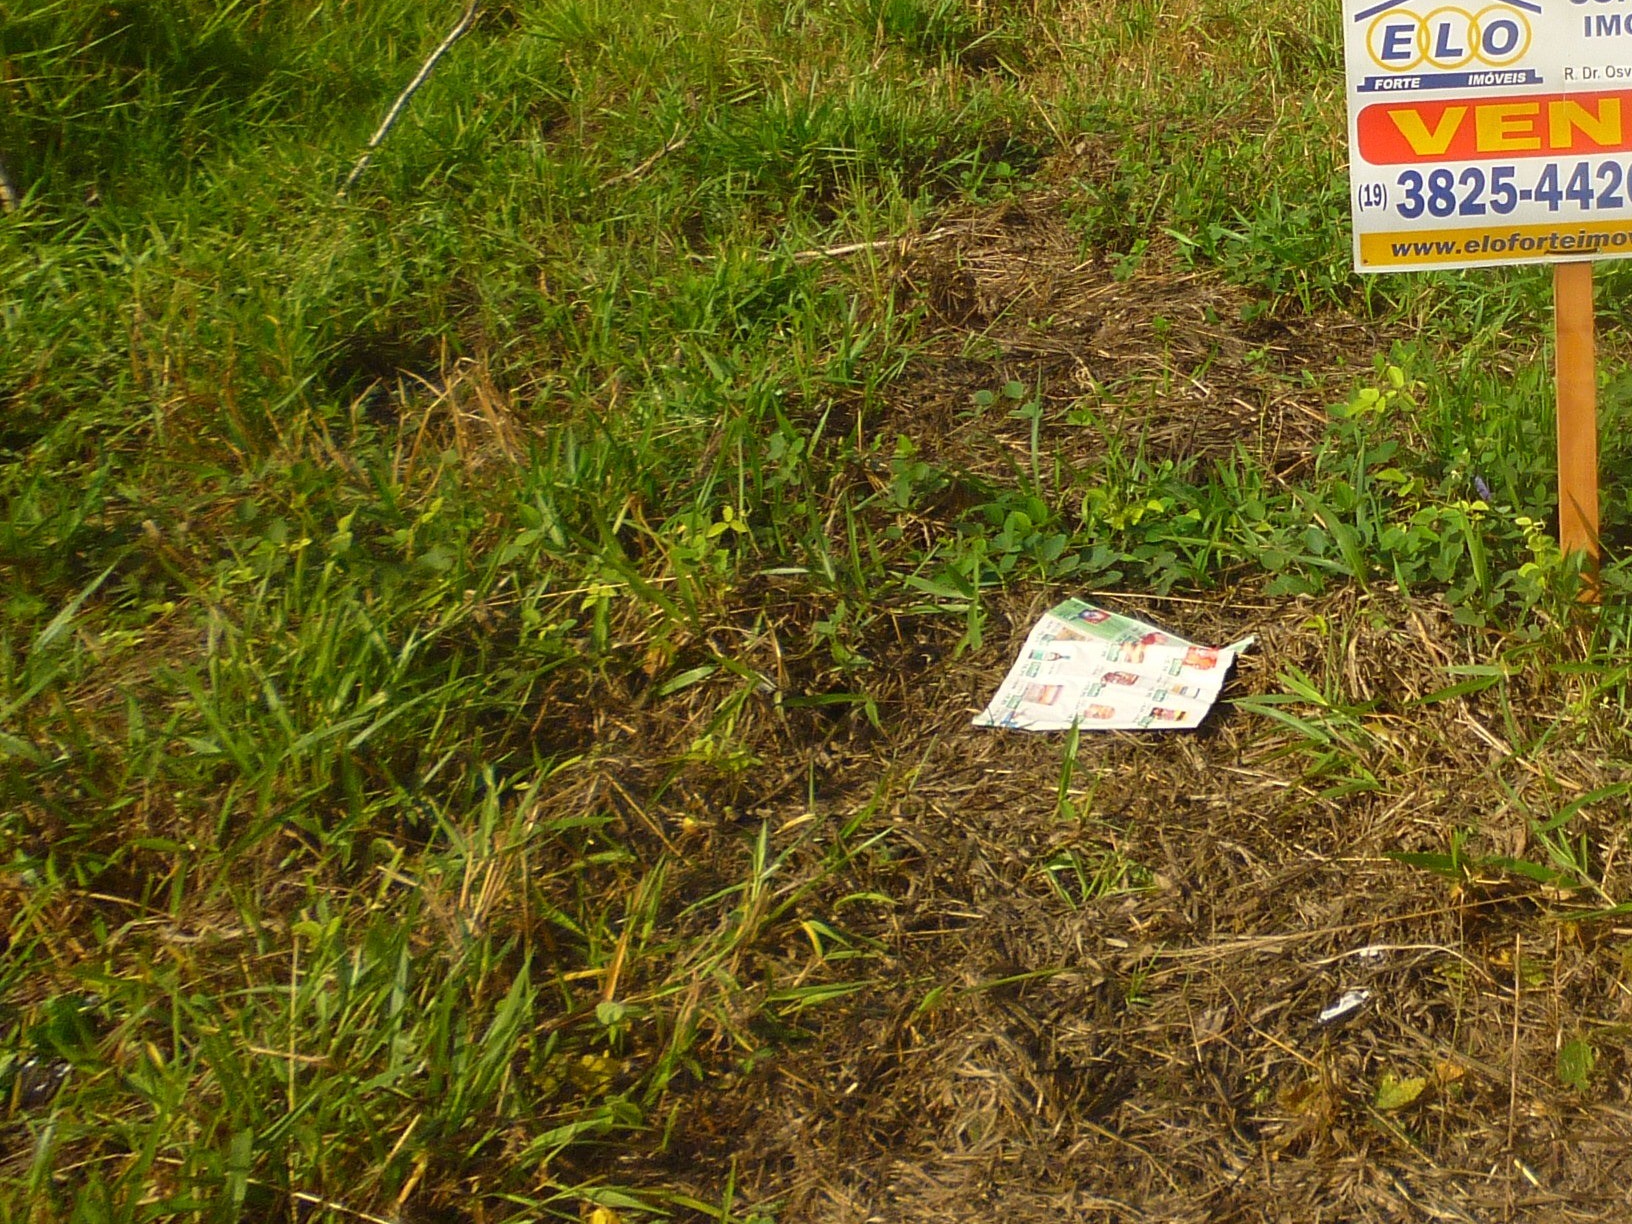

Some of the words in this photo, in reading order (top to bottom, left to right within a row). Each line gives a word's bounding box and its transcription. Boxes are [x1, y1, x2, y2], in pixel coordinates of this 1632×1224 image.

[1381, 20, 1519, 60] ELO
[1374, 77, 1420, 90] FORTE
[1468, 71, 1527, 87] IMÓVEIS
[1564, 67, 1579, 80] R.
[1583, 65, 1602, 80] Dr.
[1358, 182, 1388, 212] (19)
